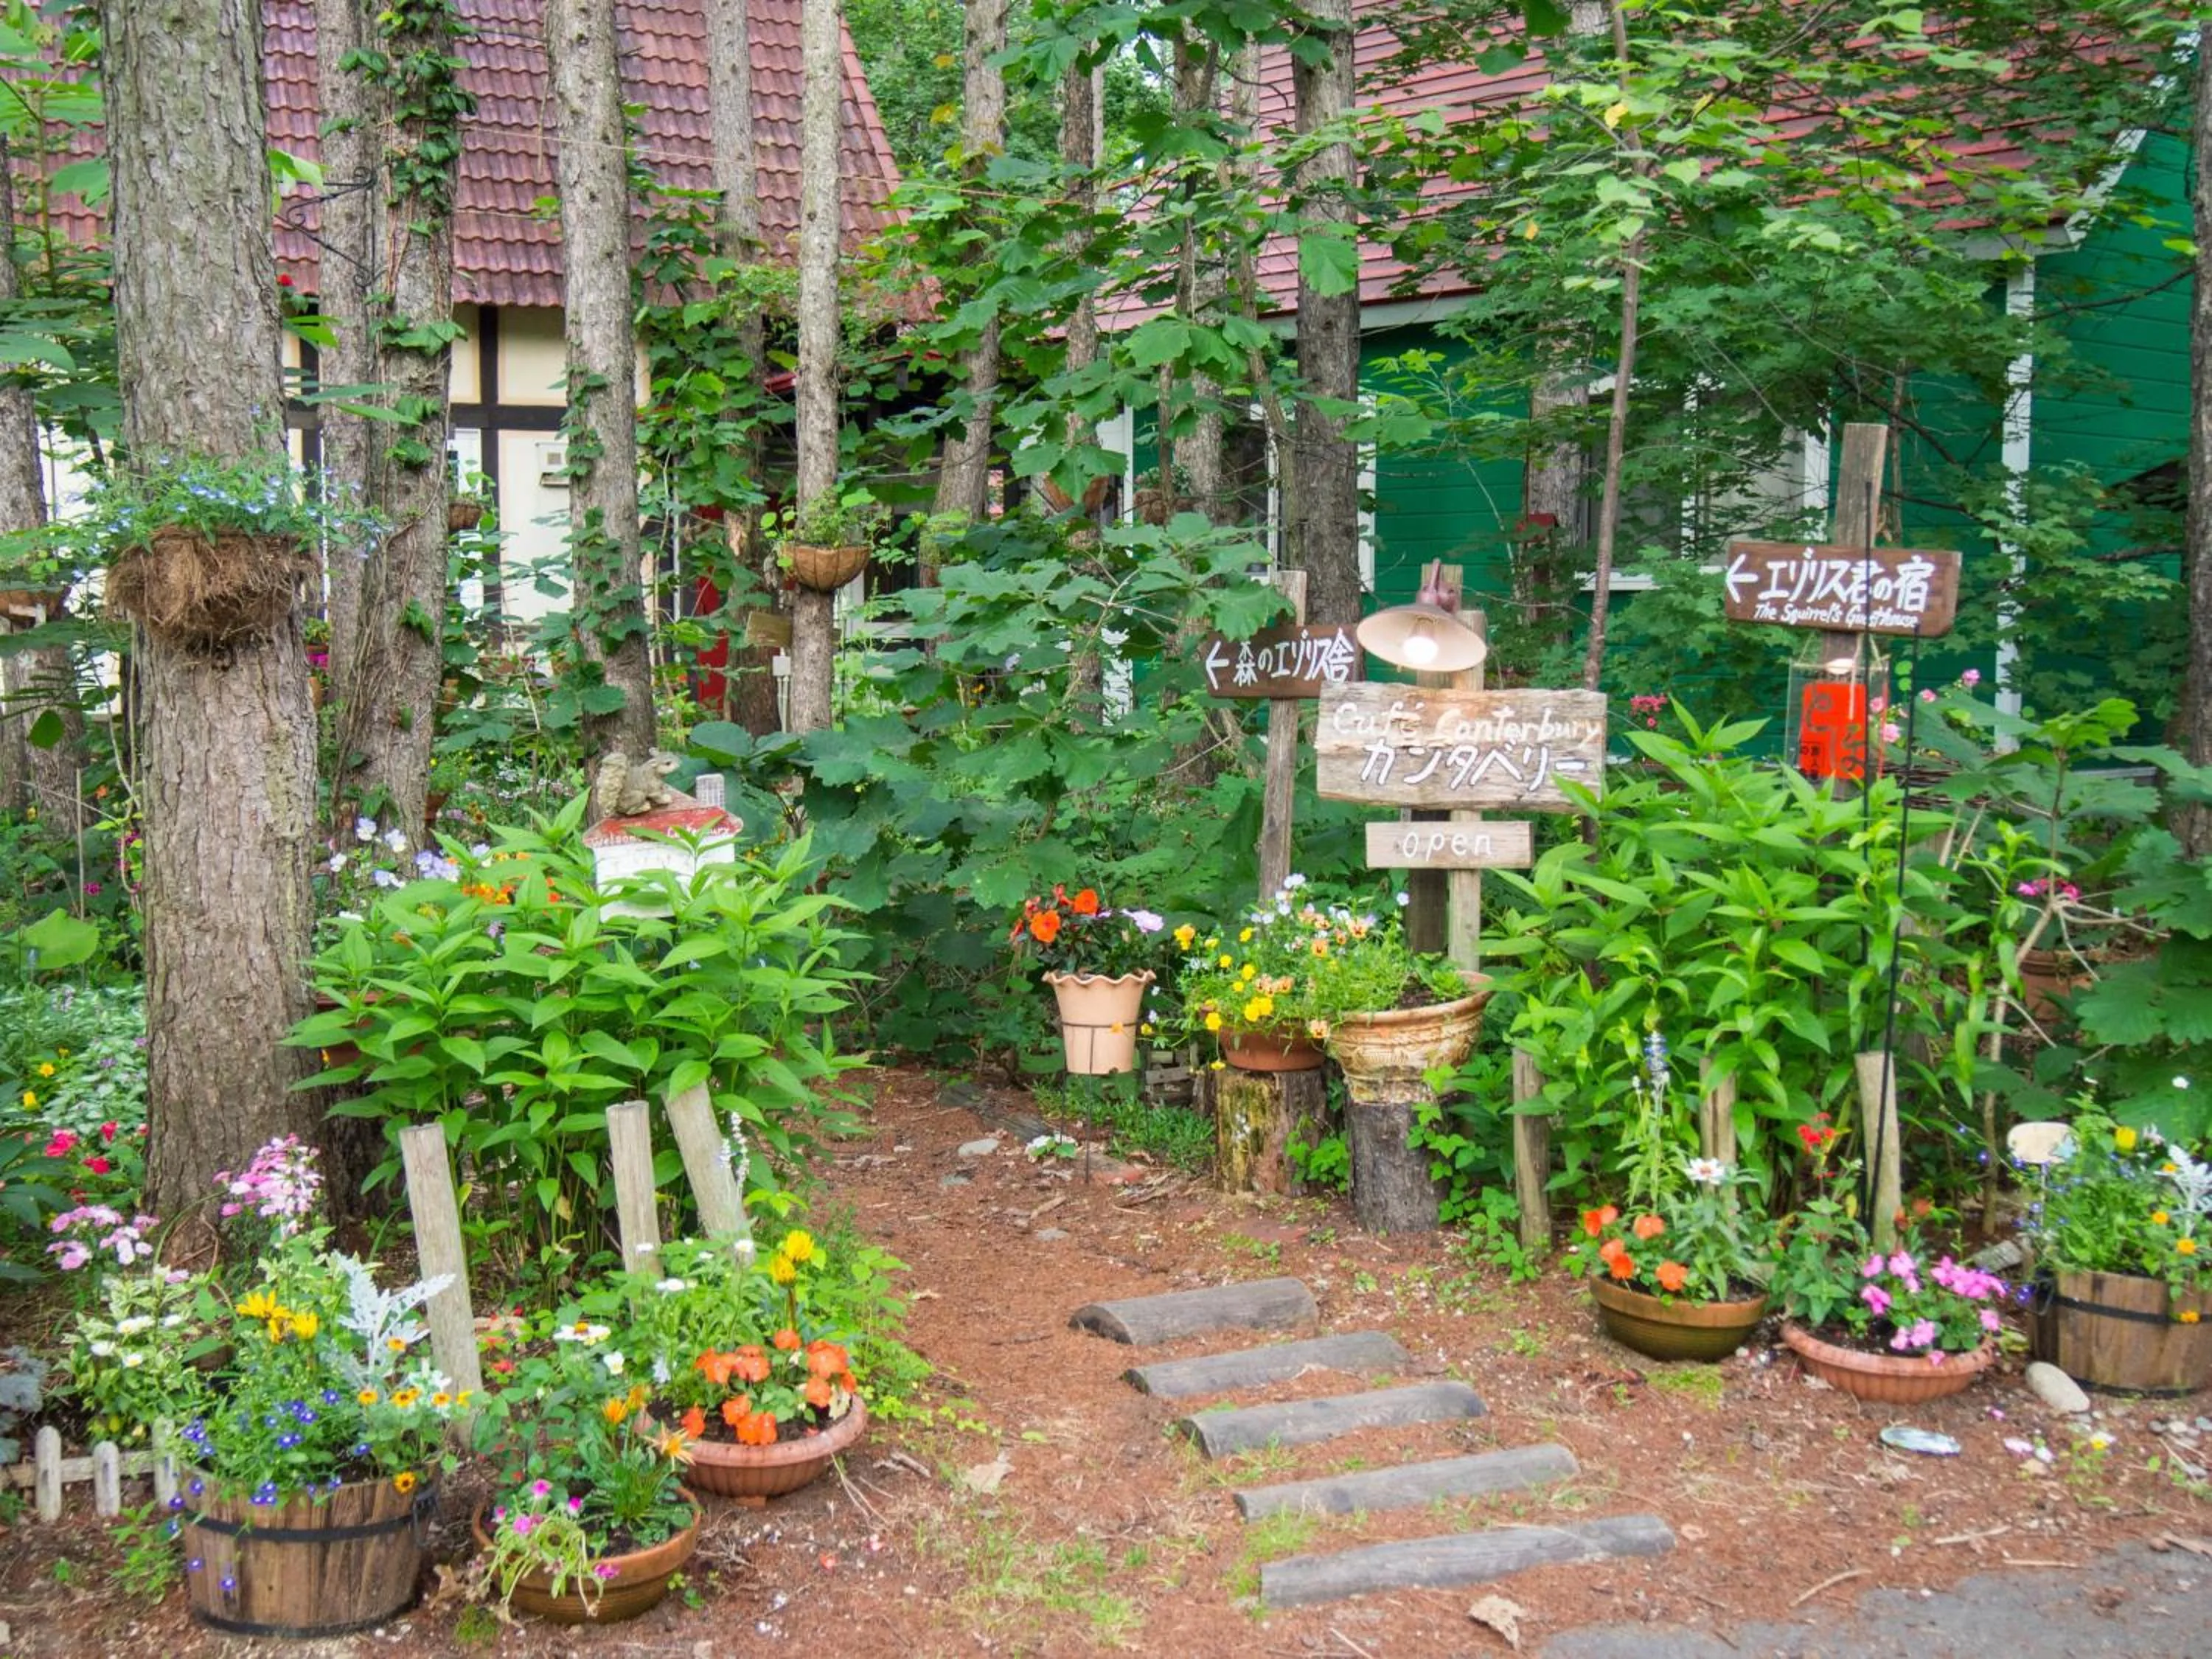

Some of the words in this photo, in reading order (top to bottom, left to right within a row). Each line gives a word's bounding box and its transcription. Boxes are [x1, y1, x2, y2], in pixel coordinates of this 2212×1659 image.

[1754, 601, 1777, 620] The
[1360, 737, 1588, 792] カンタベリー
